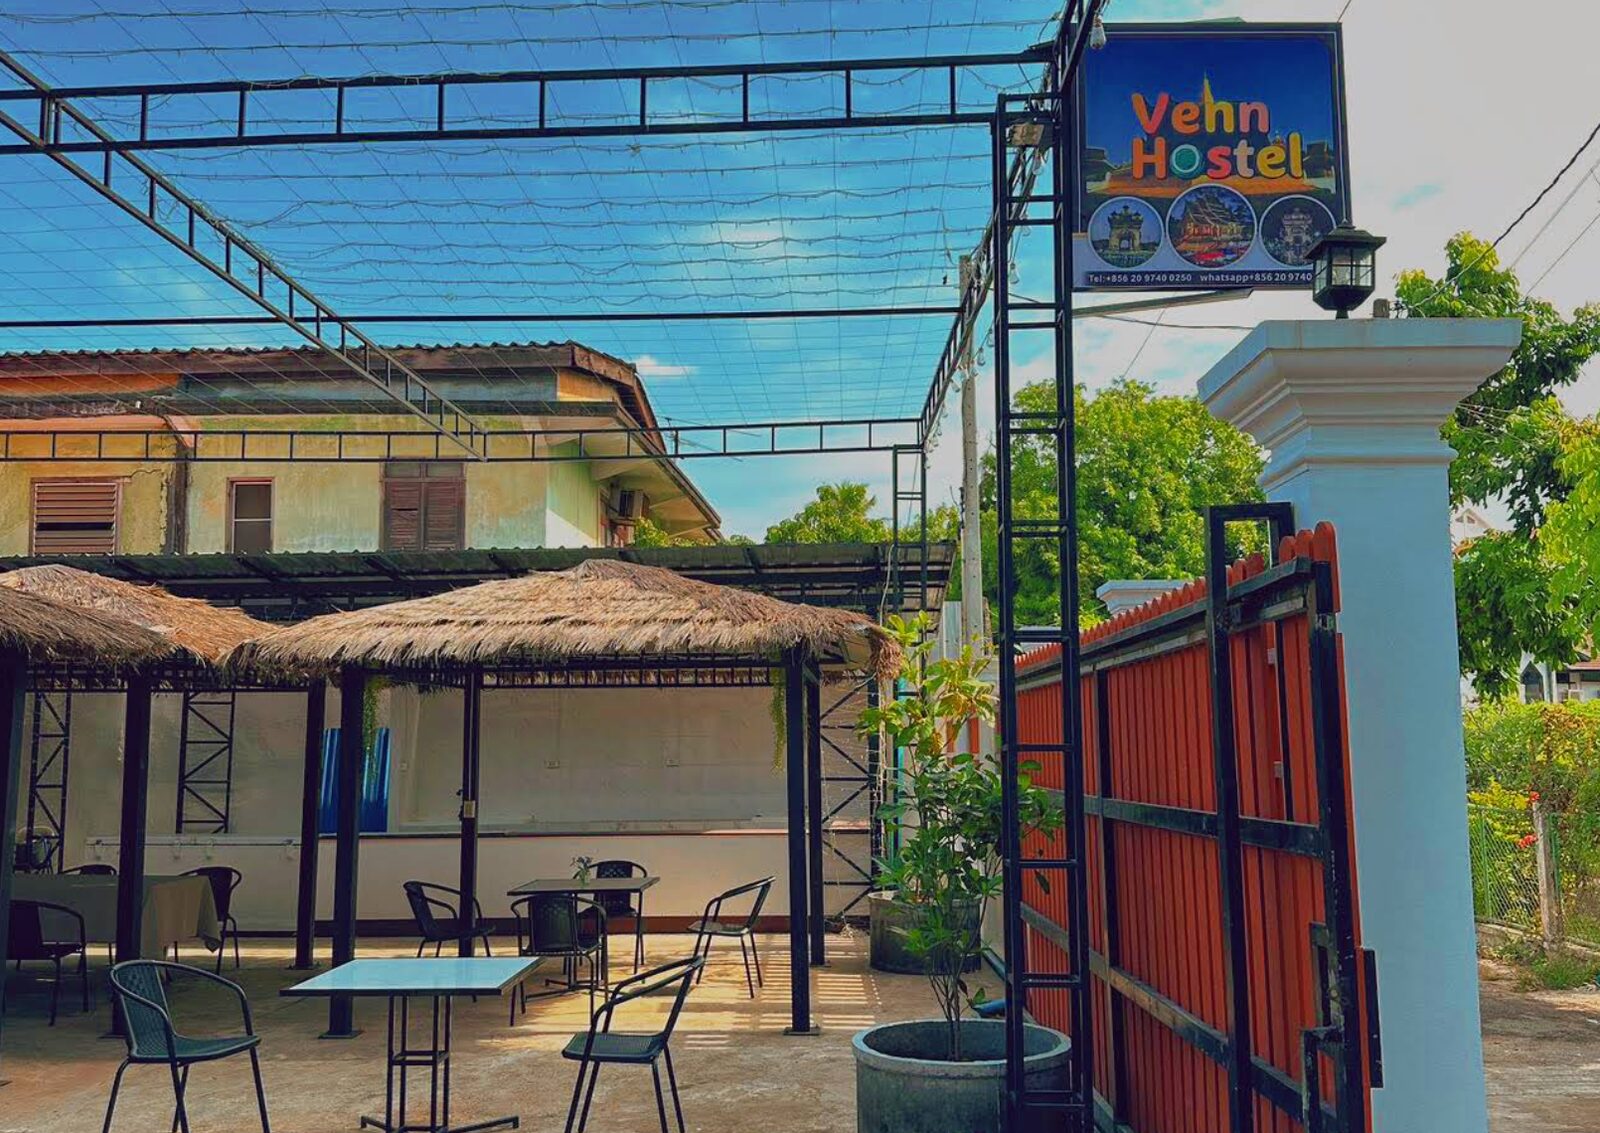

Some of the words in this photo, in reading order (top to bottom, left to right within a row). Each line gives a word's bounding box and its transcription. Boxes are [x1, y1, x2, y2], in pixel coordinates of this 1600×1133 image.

[1131, 79, 1270, 135] Vehn
[1131, 131, 1304, 180] Hostel
[1130, 273, 1142, 283] 20
[1143, 273, 1167, 283] 9740
[1168, 273, 1192, 282] 0250
[1274, 272, 1286, 282] 20
[1287, 272, 1313, 282] 9740
